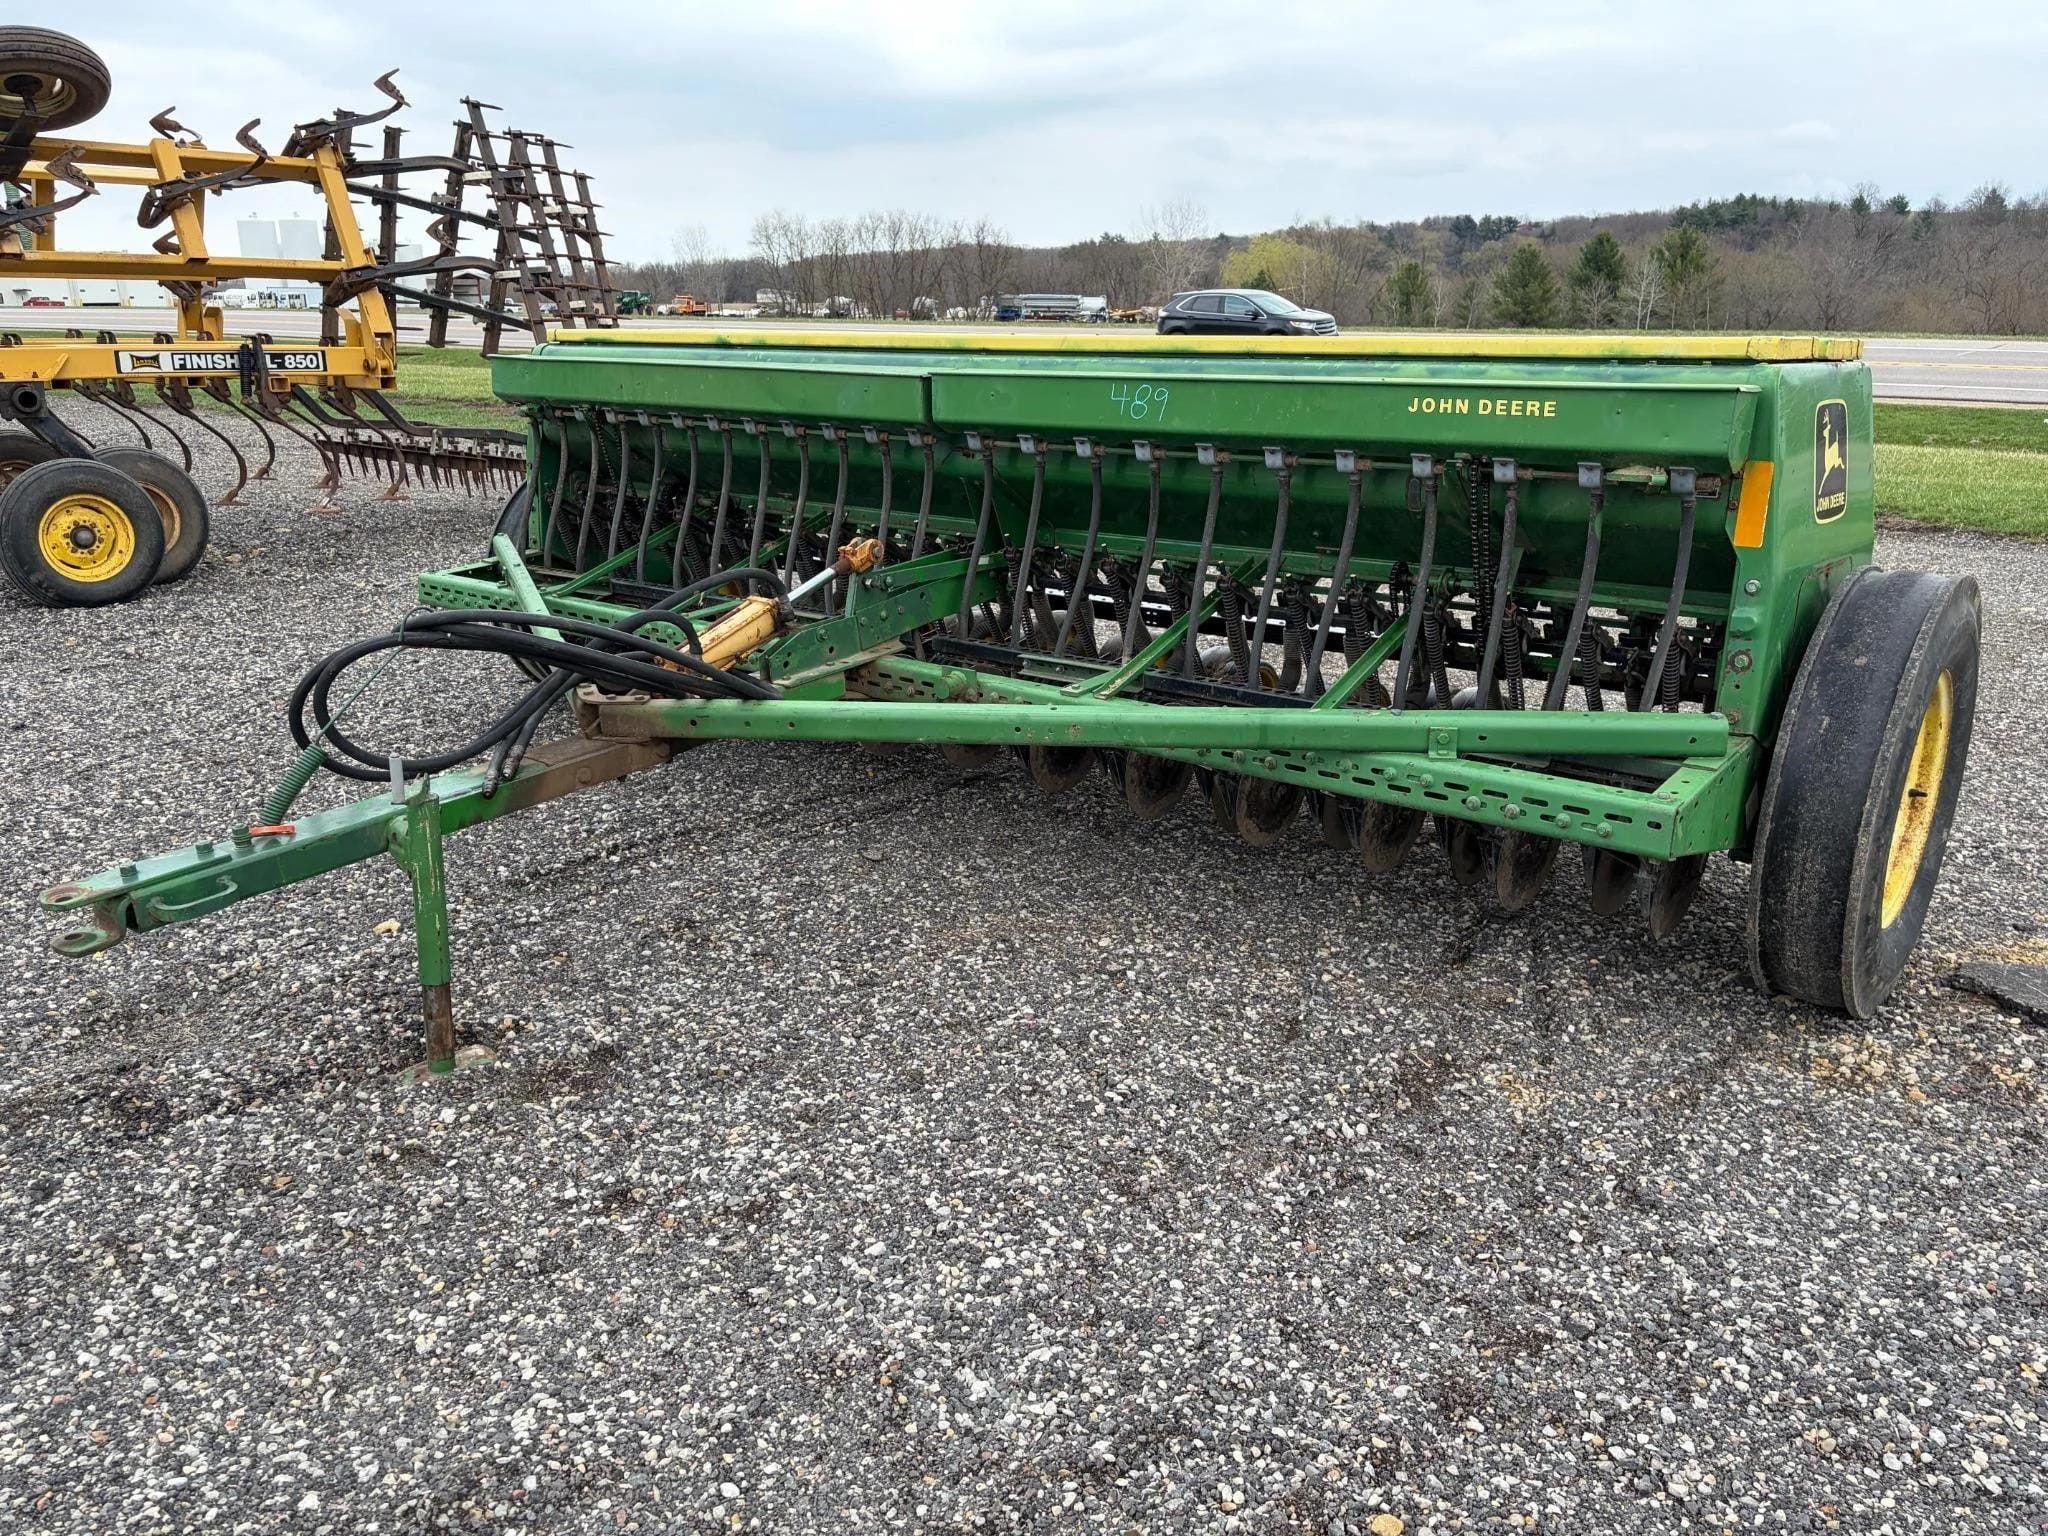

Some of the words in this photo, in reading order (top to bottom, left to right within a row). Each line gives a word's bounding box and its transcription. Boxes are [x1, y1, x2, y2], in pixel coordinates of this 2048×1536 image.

[1111, 383, 1169, 422] 489
[1408, 397, 1469, 414] JOHN
[1478, 399, 1557, 417] DEERE
